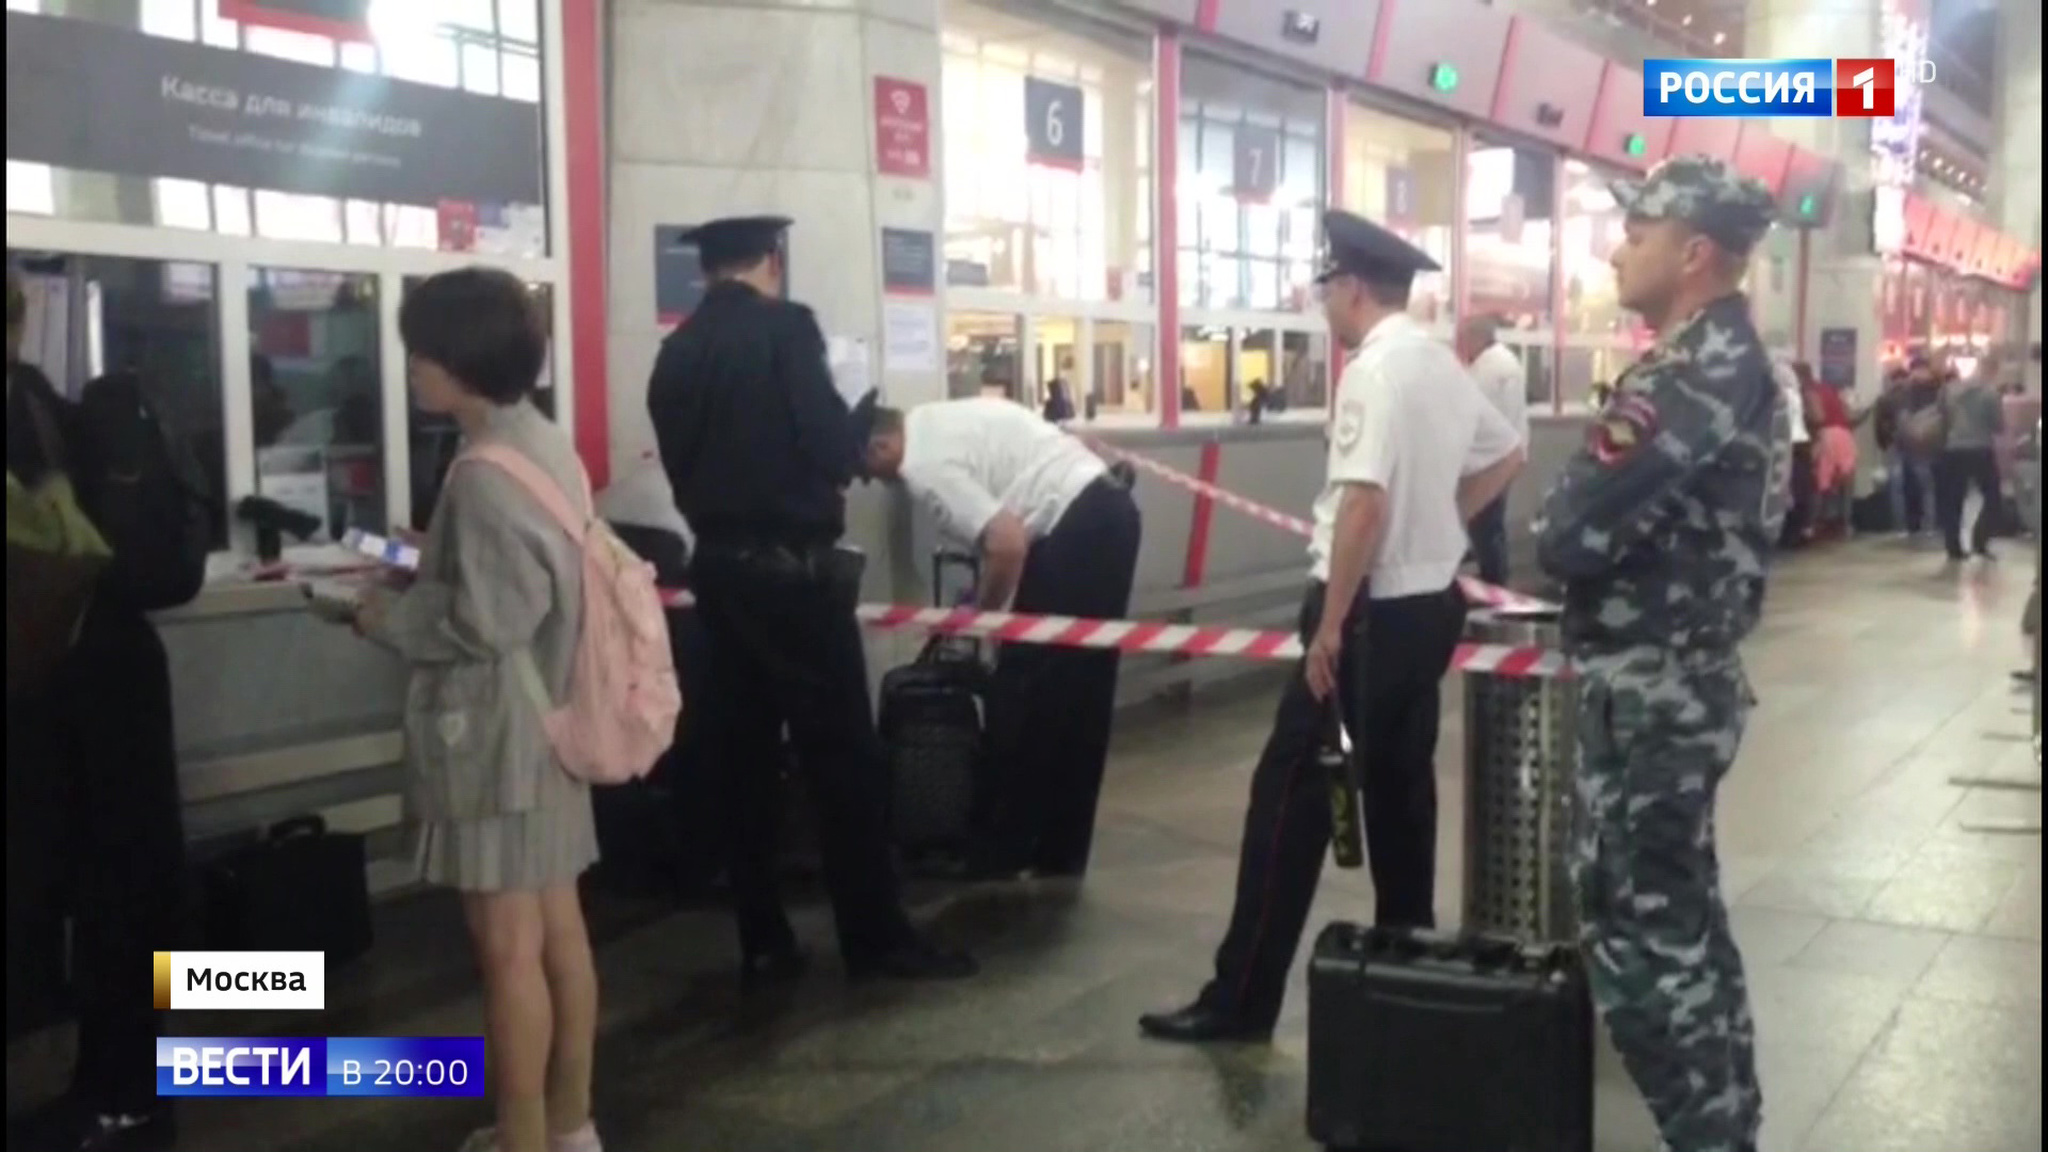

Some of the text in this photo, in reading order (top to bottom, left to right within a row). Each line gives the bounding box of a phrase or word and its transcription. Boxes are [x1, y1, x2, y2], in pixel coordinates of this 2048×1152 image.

[162, 76, 421, 137] Касса для инвалидов
[1046, 100, 1063, 146] 6
[1249, 149, 1262, 187] 7
